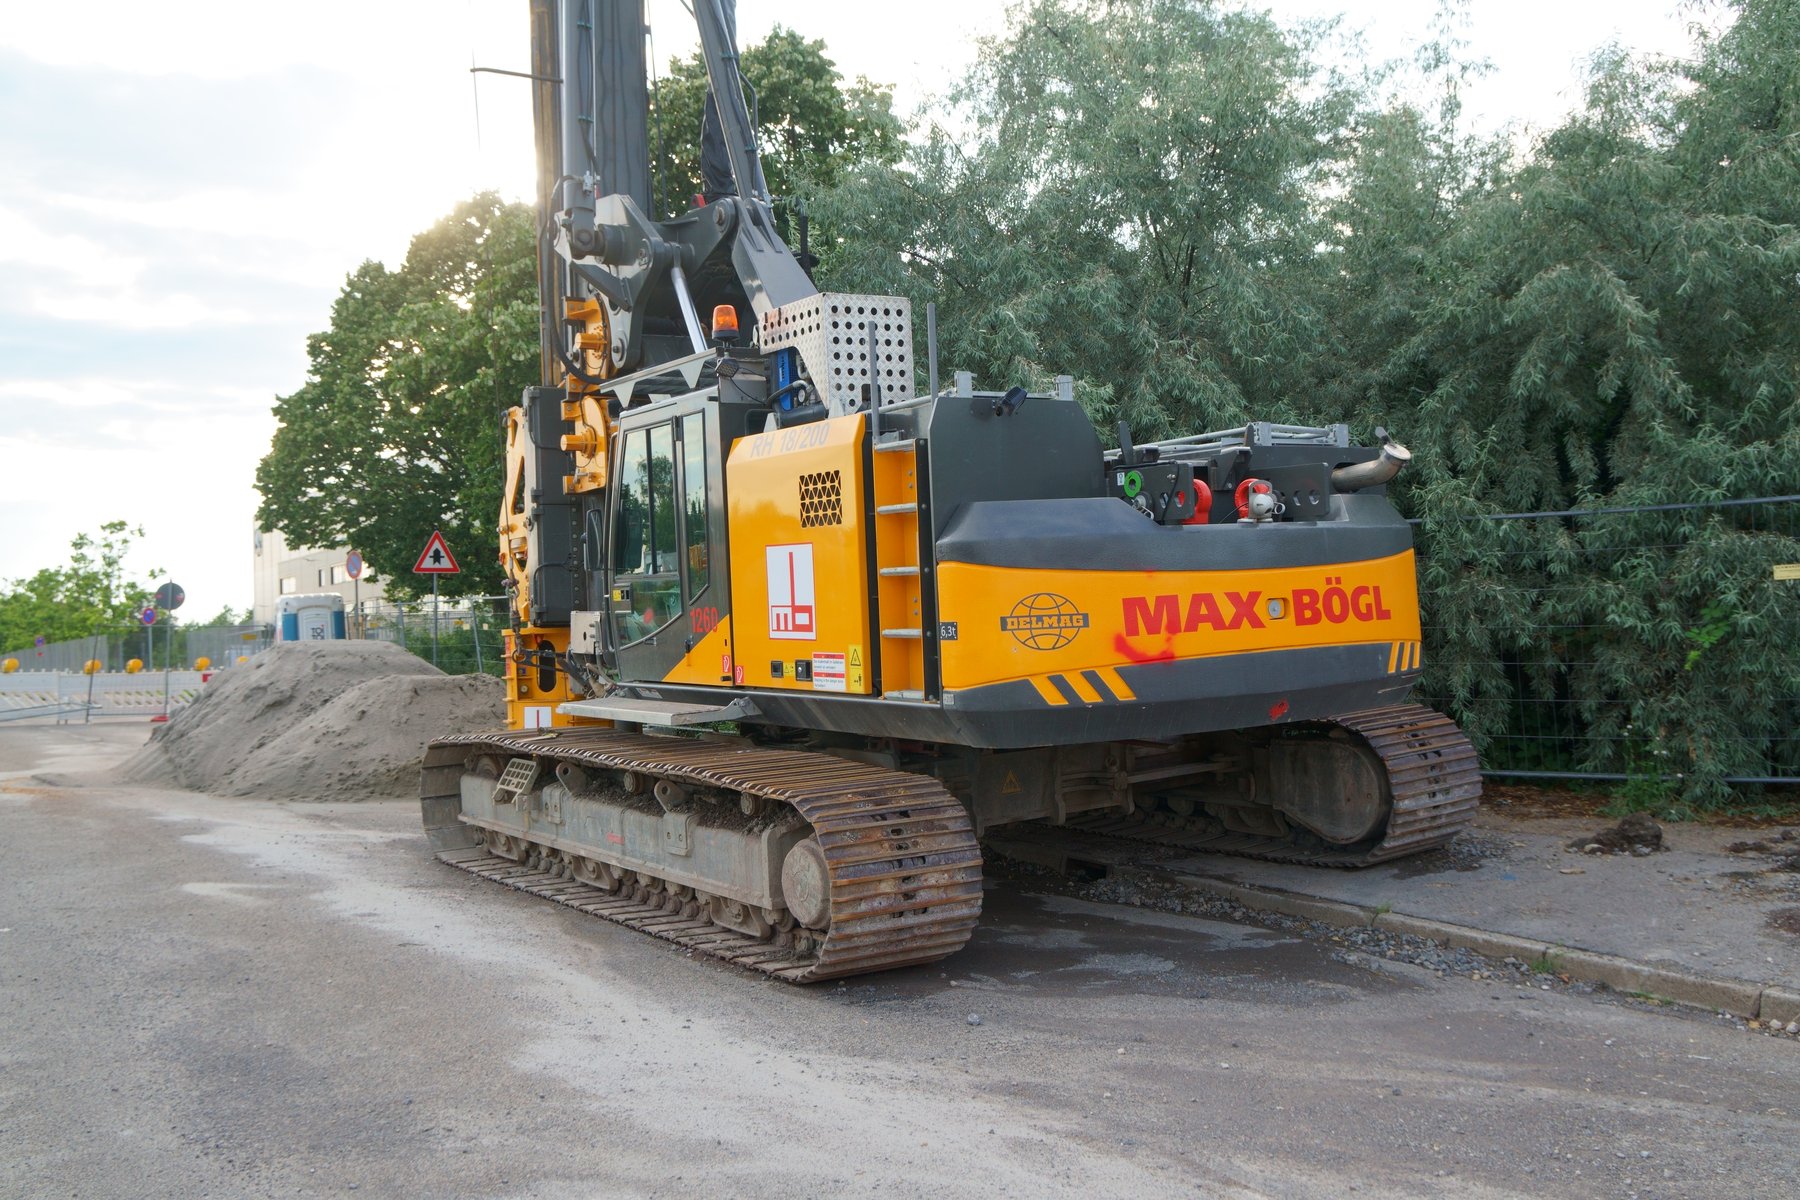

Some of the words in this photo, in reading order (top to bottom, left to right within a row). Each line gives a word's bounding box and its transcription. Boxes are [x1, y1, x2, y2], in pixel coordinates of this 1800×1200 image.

[750, 433, 775, 458] RH
[780, 421, 831, 453] 18/200
[1121, 591, 1266, 637] MAX
[1292, 576, 1391, 626] BÖGL
[690, 607, 719, 633] 1260
[940, 625, 956, 639] 6,3t
[1006, 614, 1084, 630] DELMAG
